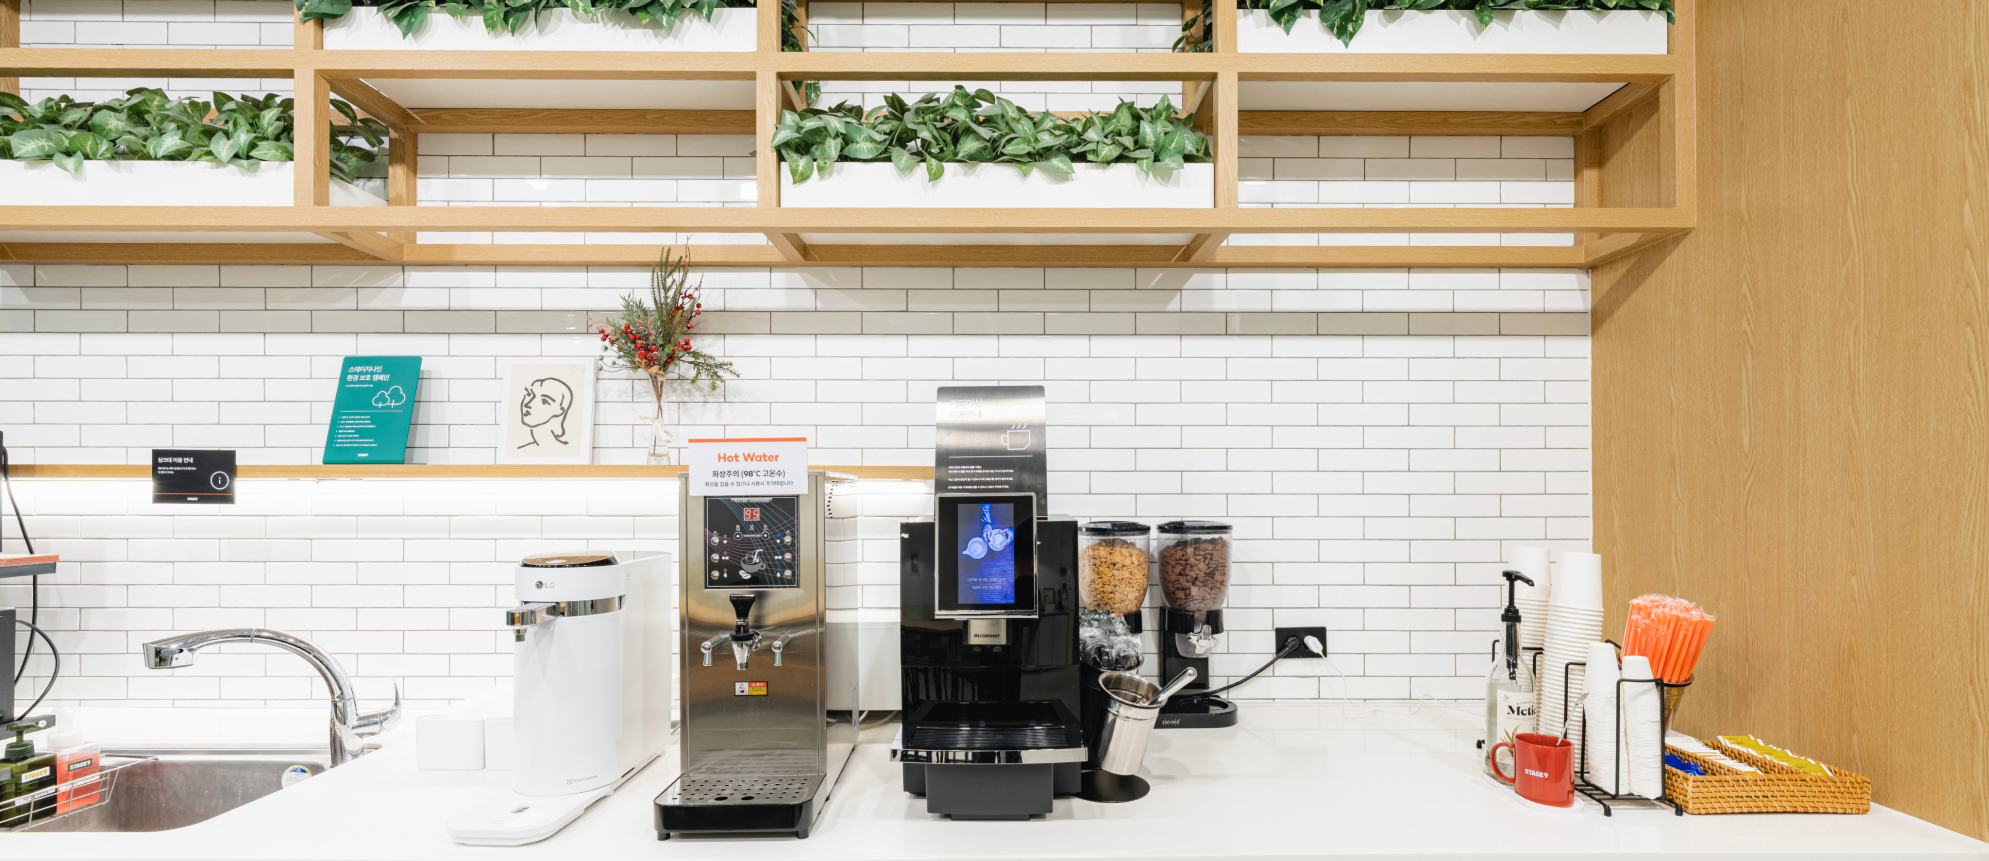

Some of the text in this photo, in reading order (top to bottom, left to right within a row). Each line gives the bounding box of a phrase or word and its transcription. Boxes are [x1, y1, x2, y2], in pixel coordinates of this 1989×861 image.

[950, 410, 983, 419] 이용안내
[717, 452, 780, 463] Hot Water
[712, 470, 740, 479] 화상주의
[762, 469, 786, 479] 고온수)
[744, 509, 759, 520] 95
[544, 581, 555, 589] LG
[69, 759, 92, 771] STAGE9
[24, 768, 48, 781] STAGE9
[1524, 768, 1549, 779] STAGE9
